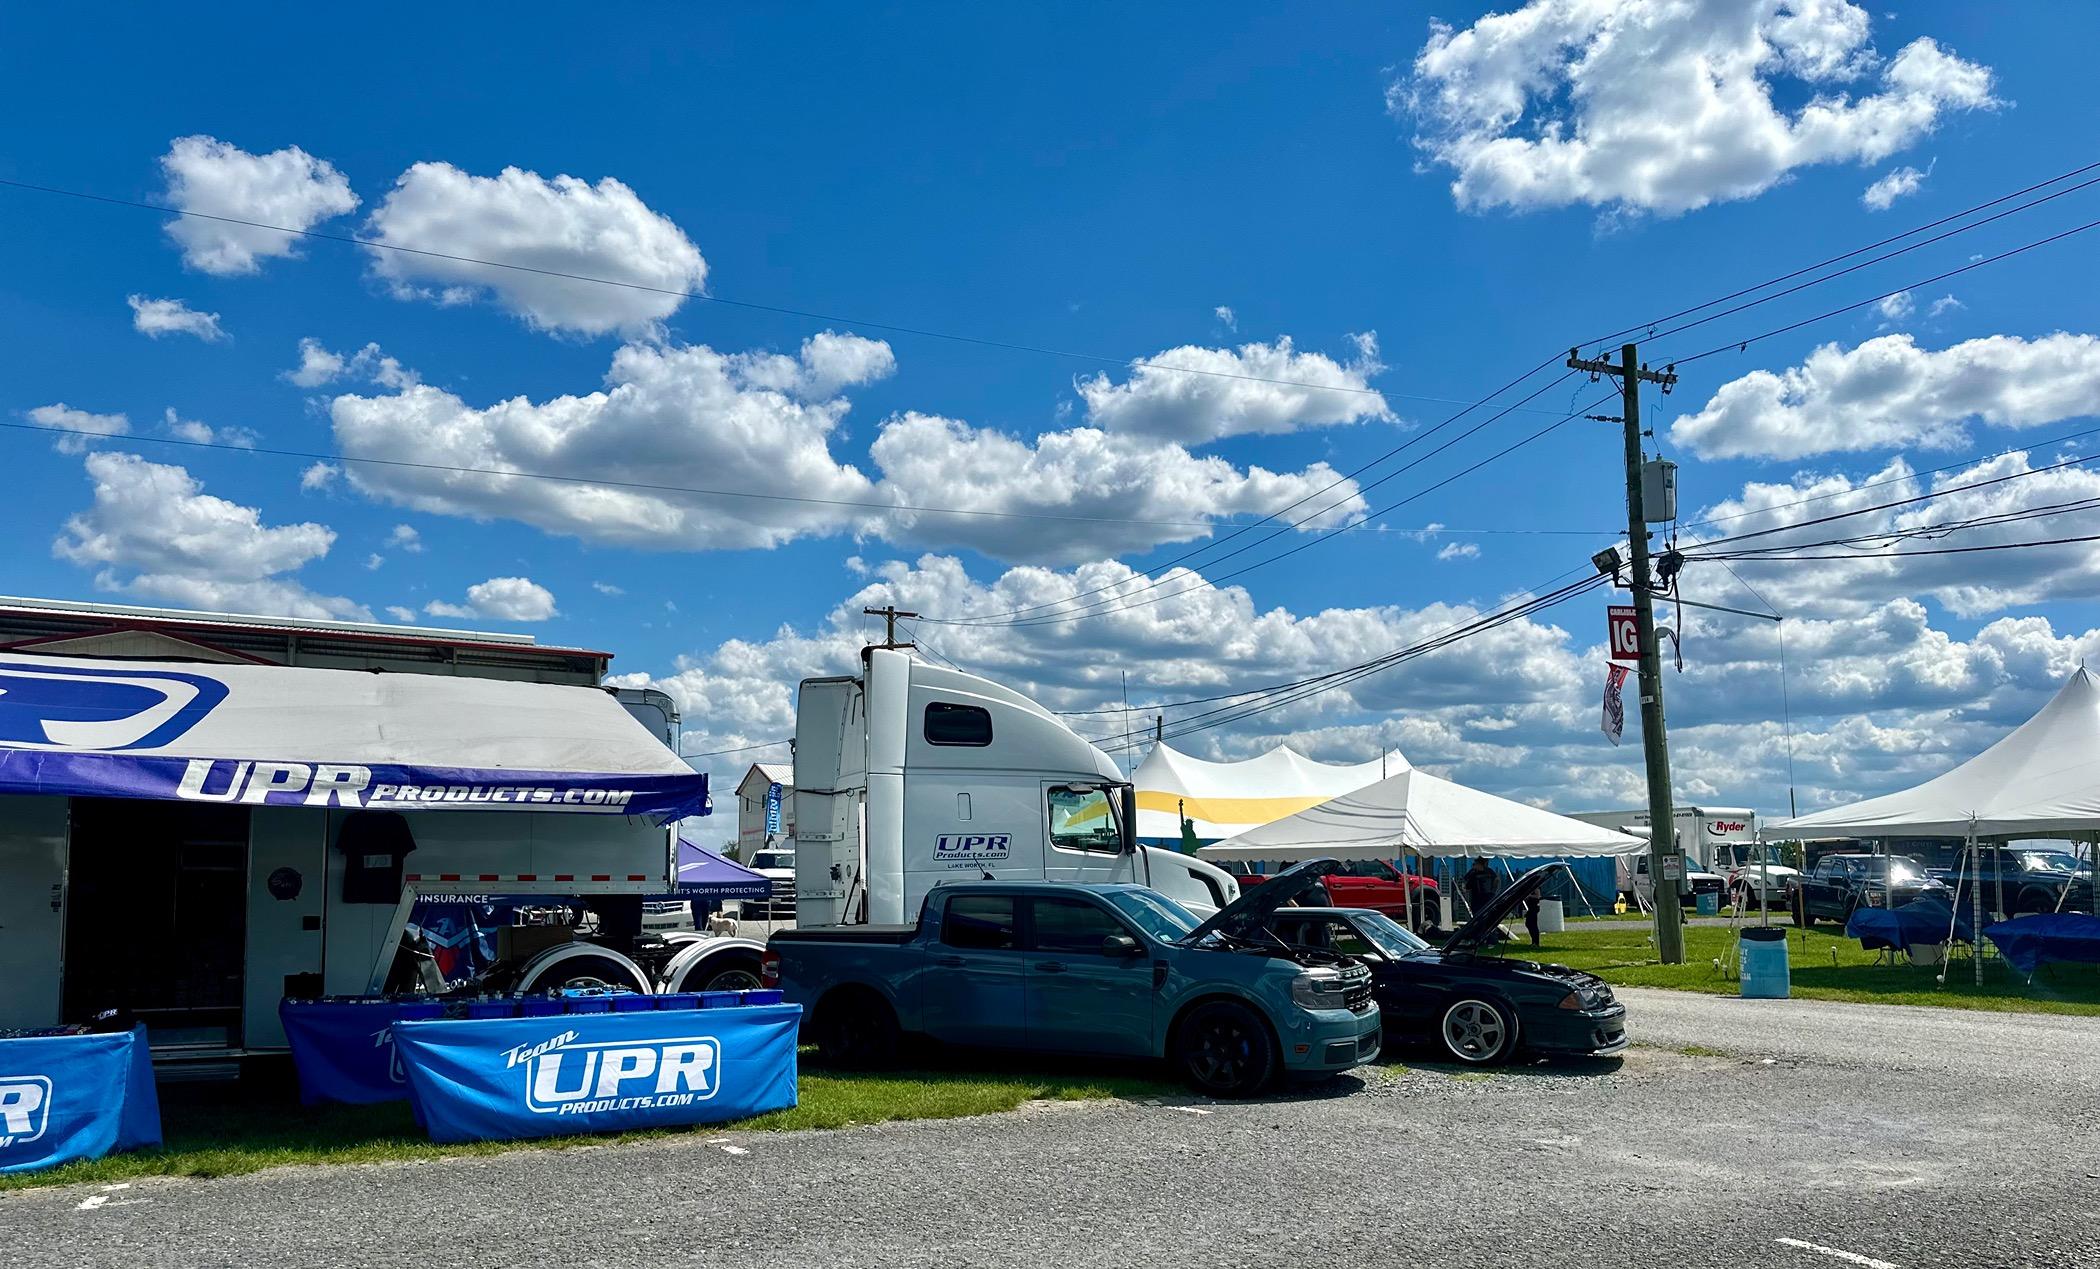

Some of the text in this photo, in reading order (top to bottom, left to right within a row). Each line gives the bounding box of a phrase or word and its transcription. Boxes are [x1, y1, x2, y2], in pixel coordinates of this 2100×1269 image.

[176, 759, 633, 807] UPR PRODUCTS.COM
[1716, 821, 1745, 832] Ryder
[938, 836, 1008, 851] UPR
[420, 894, 488, 903] INSURANCE
[500, 1030, 579, 1069] Team
[534, 1044, 714, 1102] UPR
[559, 1094, 693, 1115] PRODUCTS.COM
